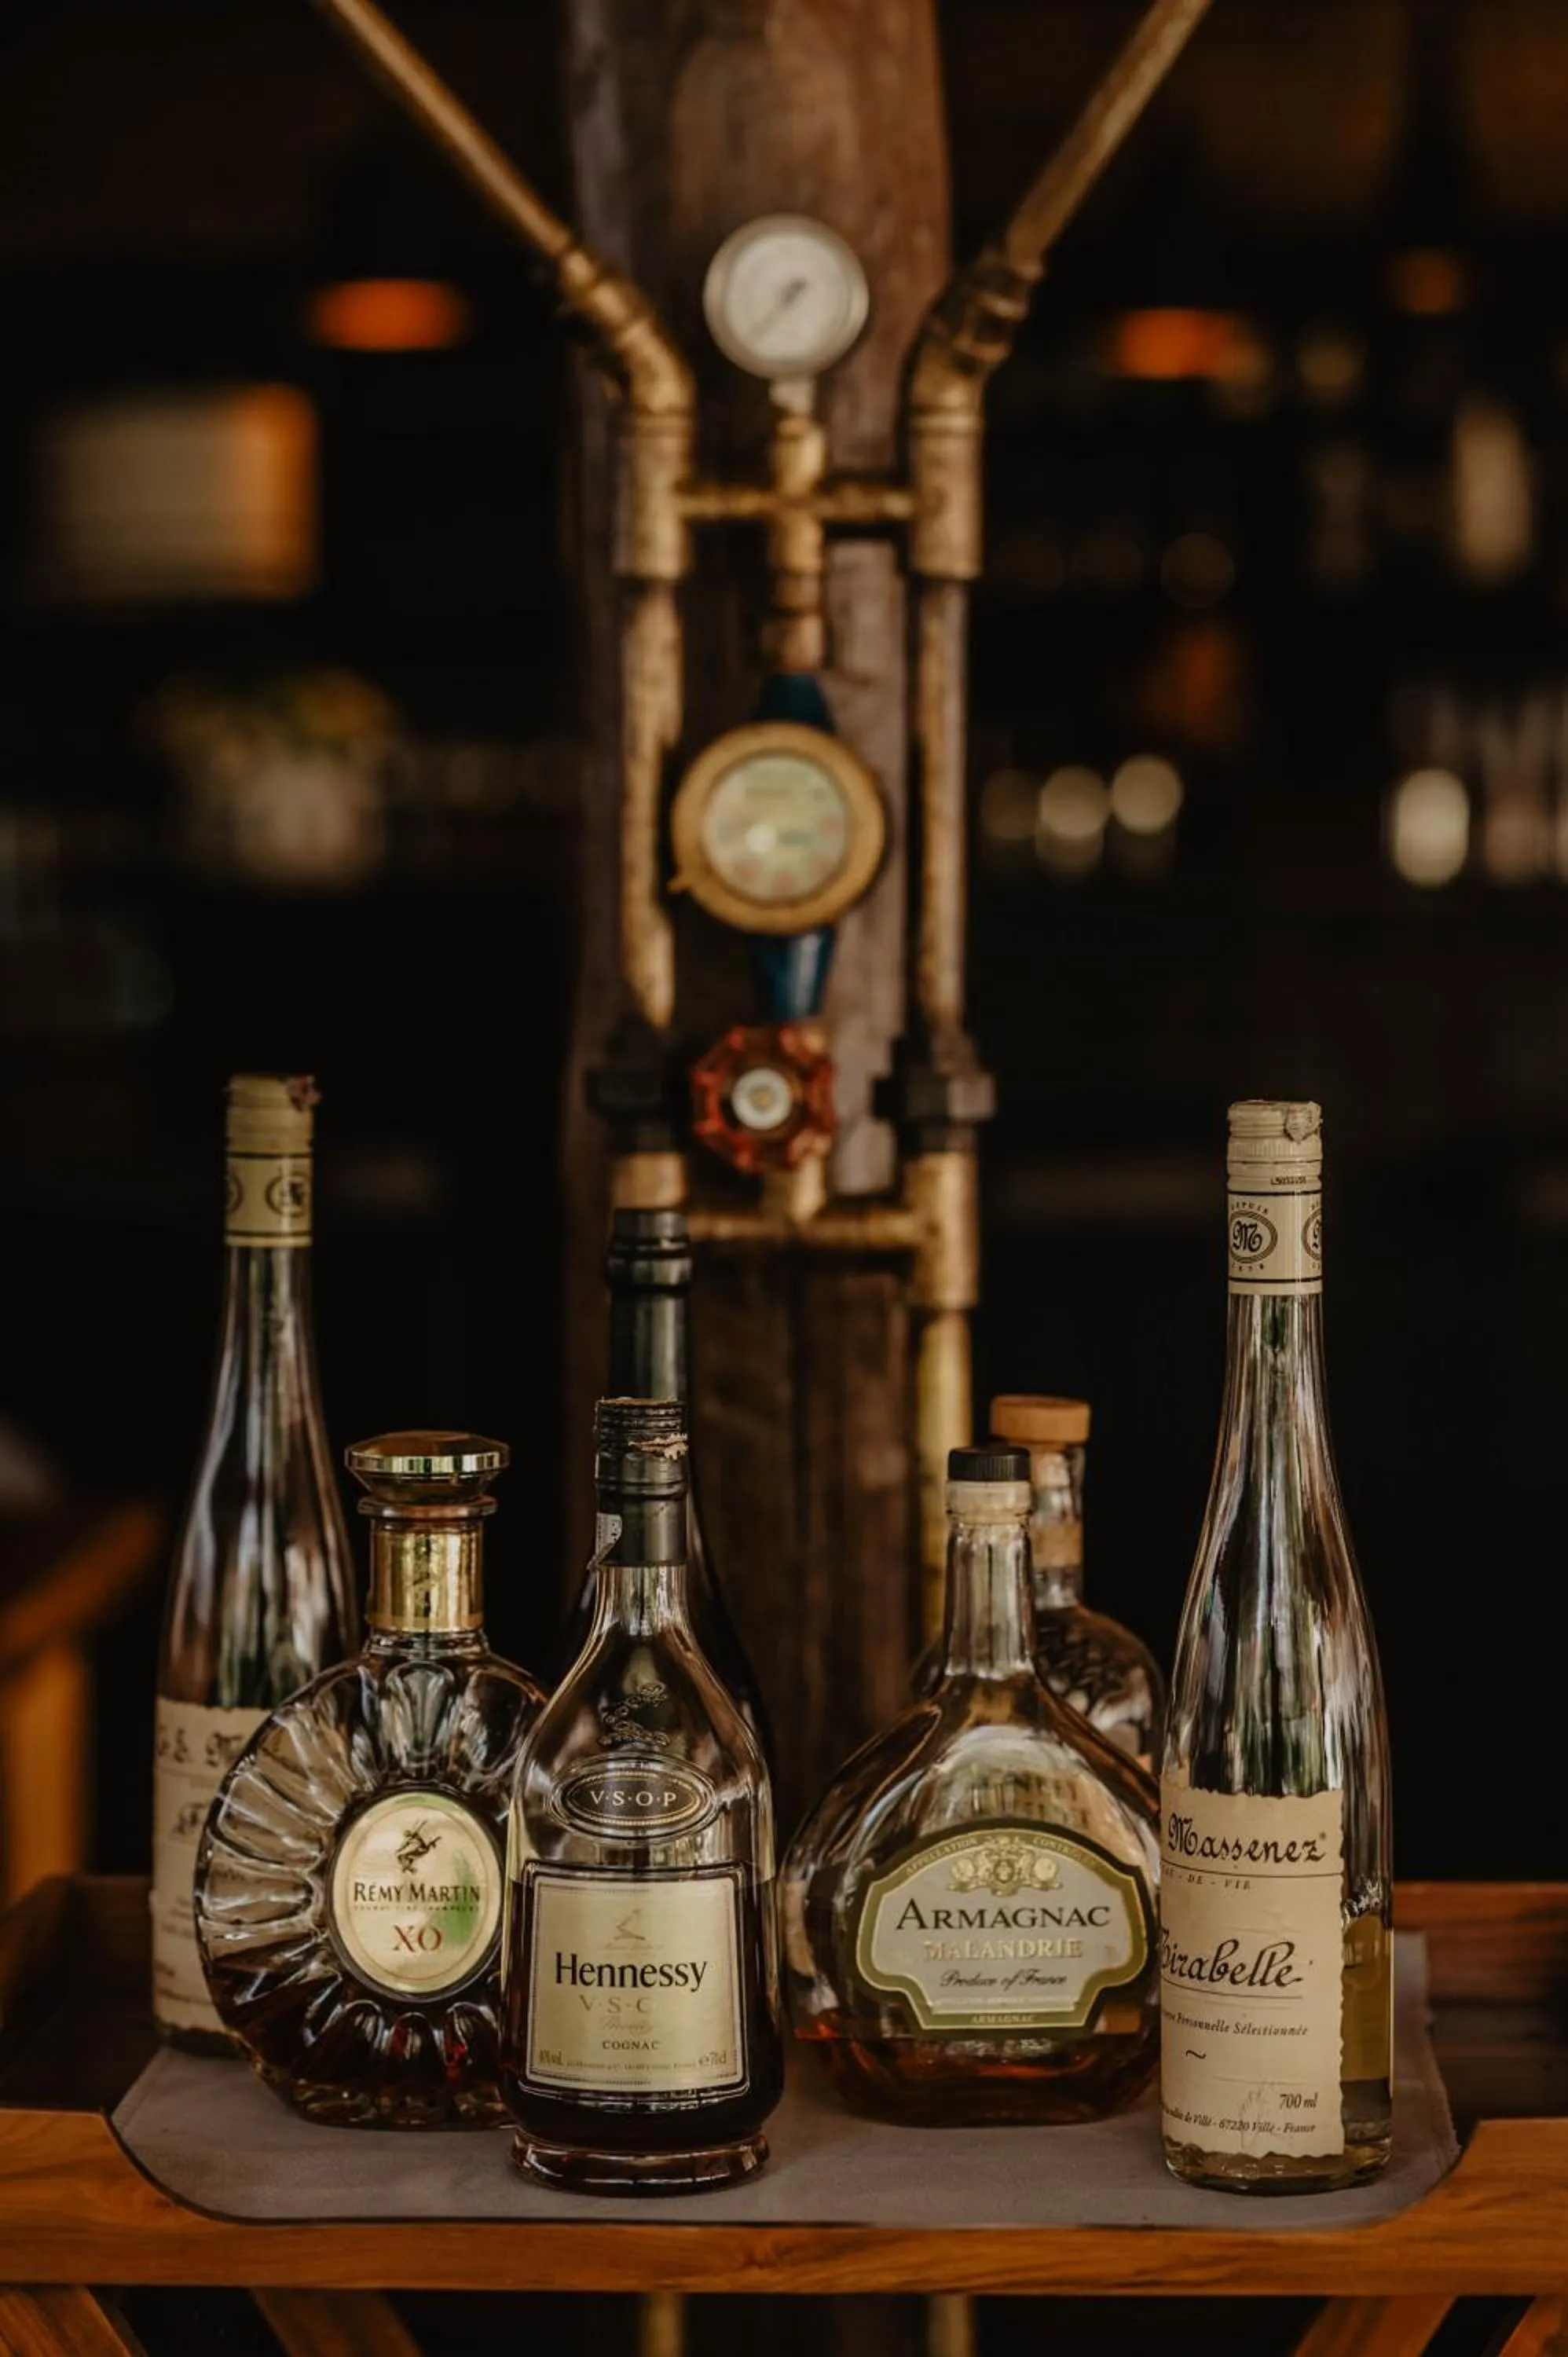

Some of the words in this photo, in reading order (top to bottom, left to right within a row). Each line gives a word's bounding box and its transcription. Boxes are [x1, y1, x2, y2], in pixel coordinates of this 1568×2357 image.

[1168, 1813, 1326, 1863] Massenez
[409, 1883, 480, 1902] MARTIN
[896, 1898, 1110, 1930] ARMAGNAC
[392, 1925, 443, 1952] XO
[555, 1952, 708, 1992] Hennessy
[940, 1970, 997, 1987] Produce
[1000, 1971, 1020, 1992] of
[1019, 1968, 1068, 1986] France
[602, 2040, 660, 2050] COGNAC
[1280, 2093, 1302, 2110] 700
[1304, 2091, 1319, 2110] ml
